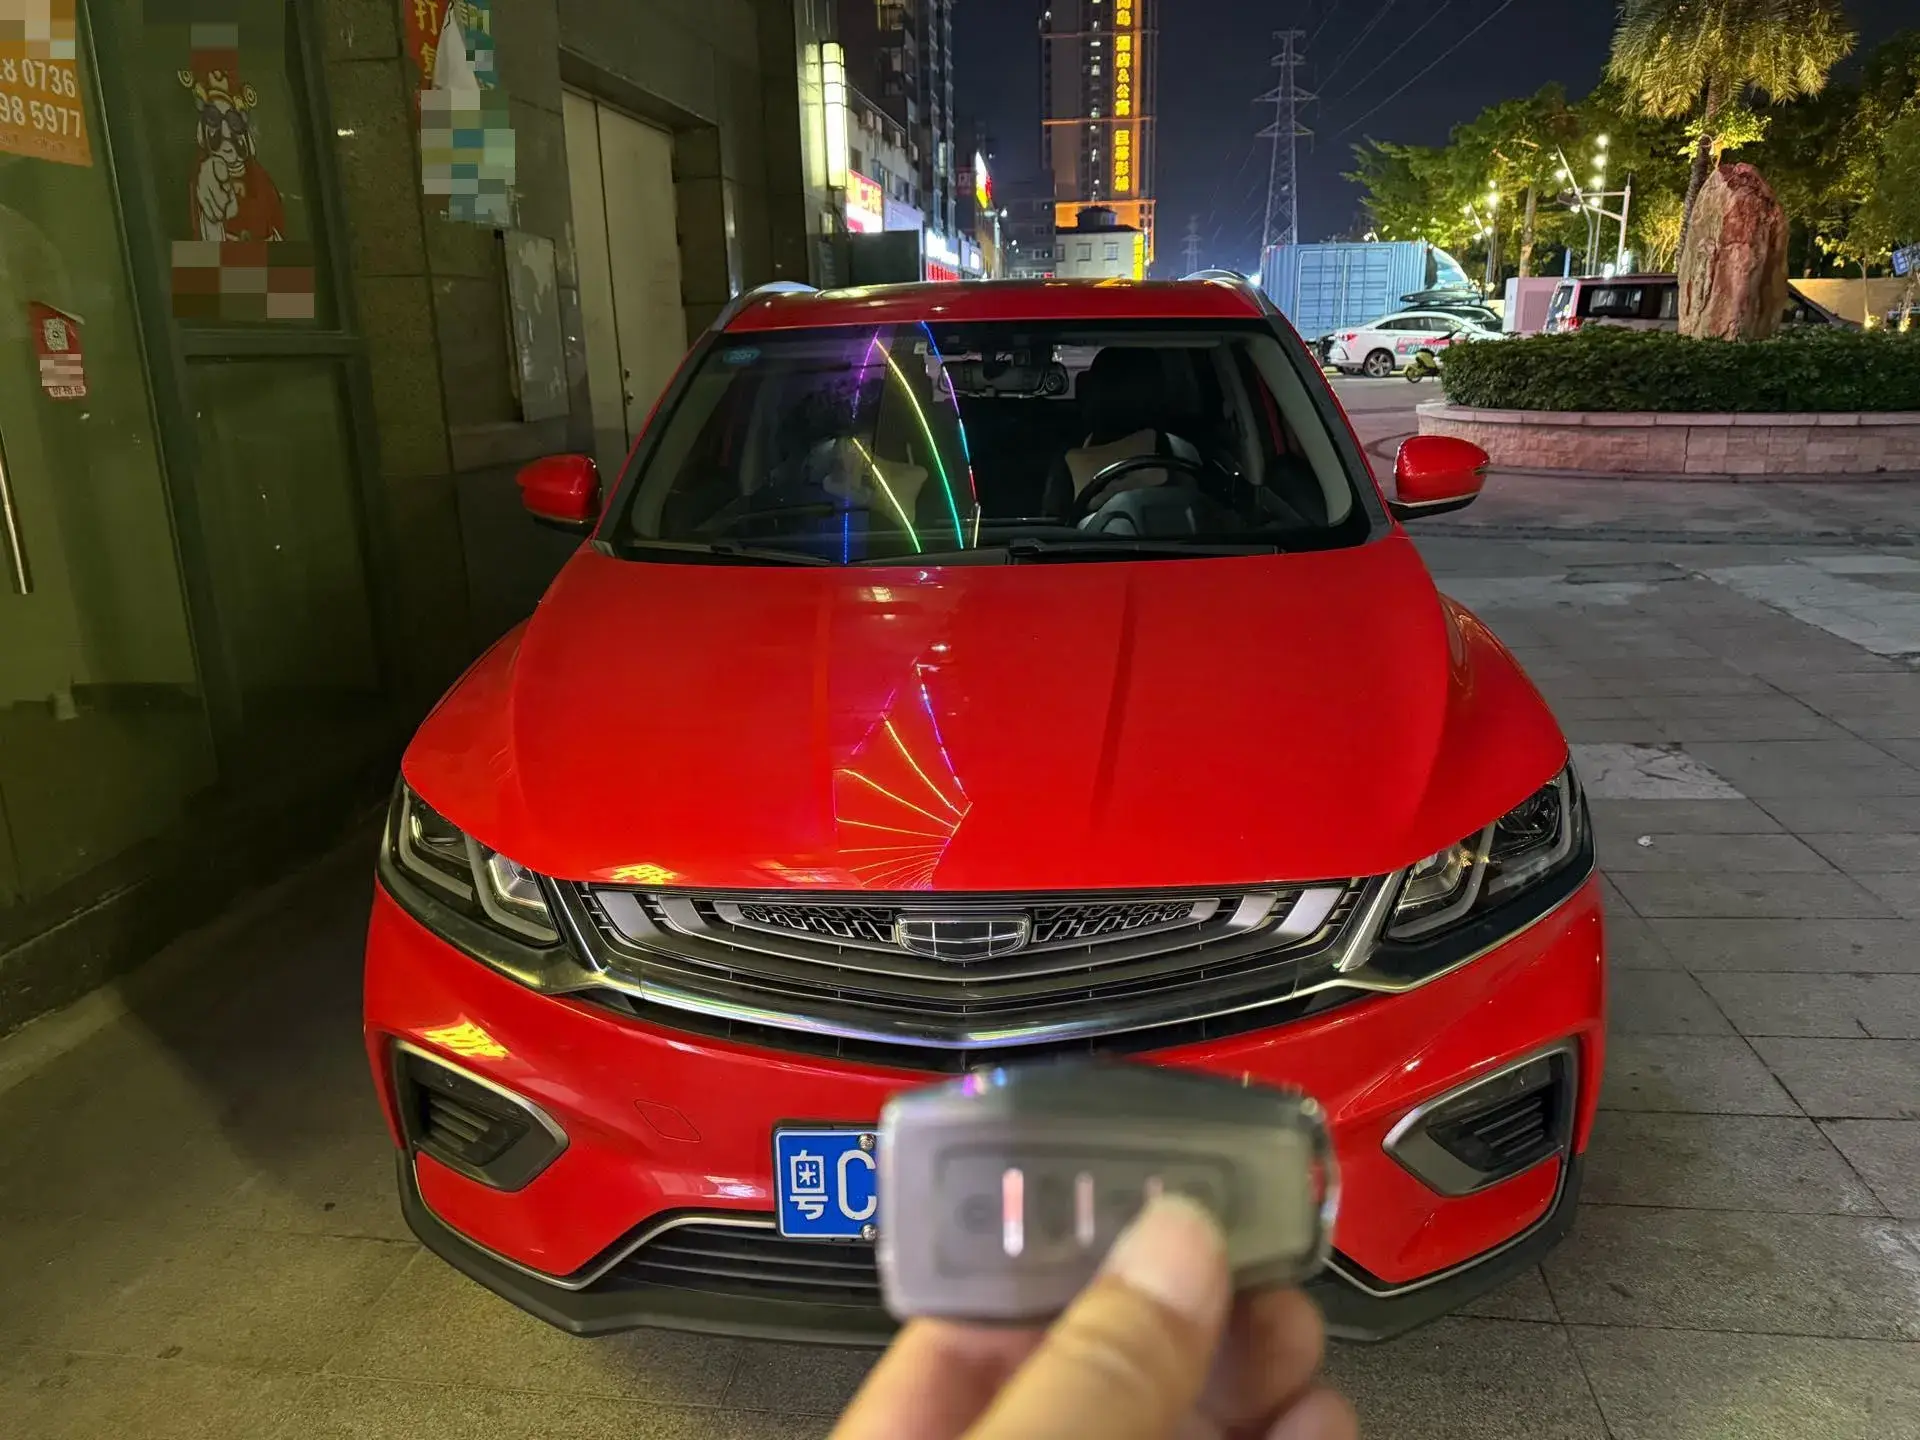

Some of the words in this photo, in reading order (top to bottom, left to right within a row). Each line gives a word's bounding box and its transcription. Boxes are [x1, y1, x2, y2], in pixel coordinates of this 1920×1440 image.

[22, 59, 76, 98] 0736
[1115, 35, 1131, 116] 酒店&公寓
[29, 100, 81, 138] 5977
[789, 1149, 878, 1221] 粤C
